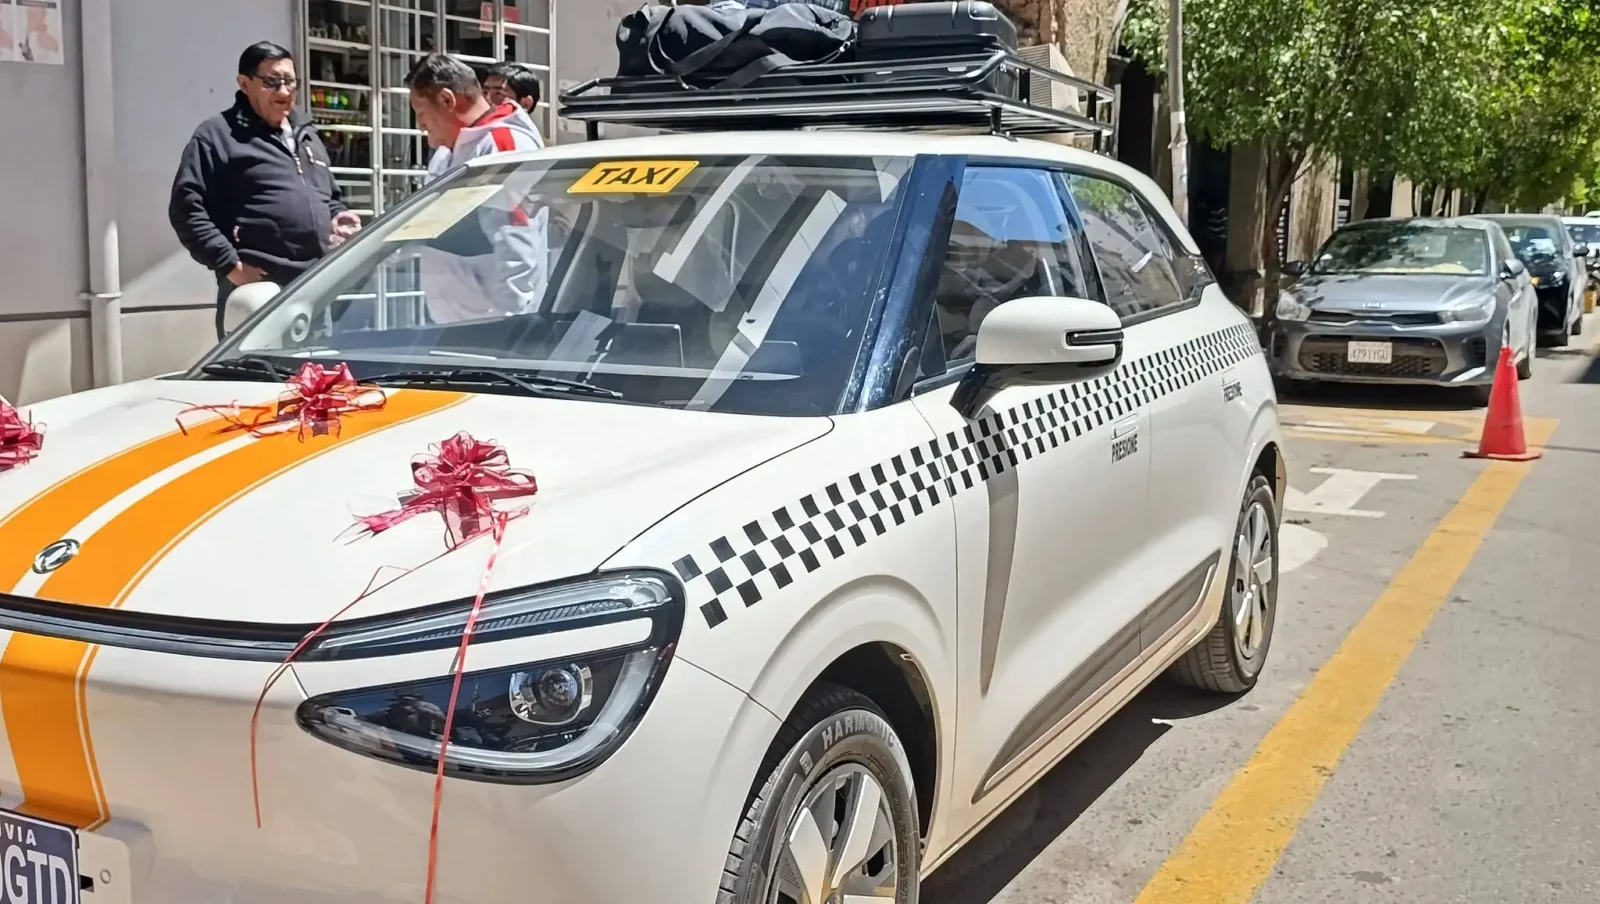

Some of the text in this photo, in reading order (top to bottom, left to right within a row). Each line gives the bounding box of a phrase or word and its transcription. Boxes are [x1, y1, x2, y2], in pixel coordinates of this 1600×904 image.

[592, 167, 681, 185] TAXI
[1111, 433, 1138, 464] PRESIONE
[821, 713, 896, 750] HARMONIC
[0, 822, 37, 846] VIA
[0, 844, 73, 904] GTD
